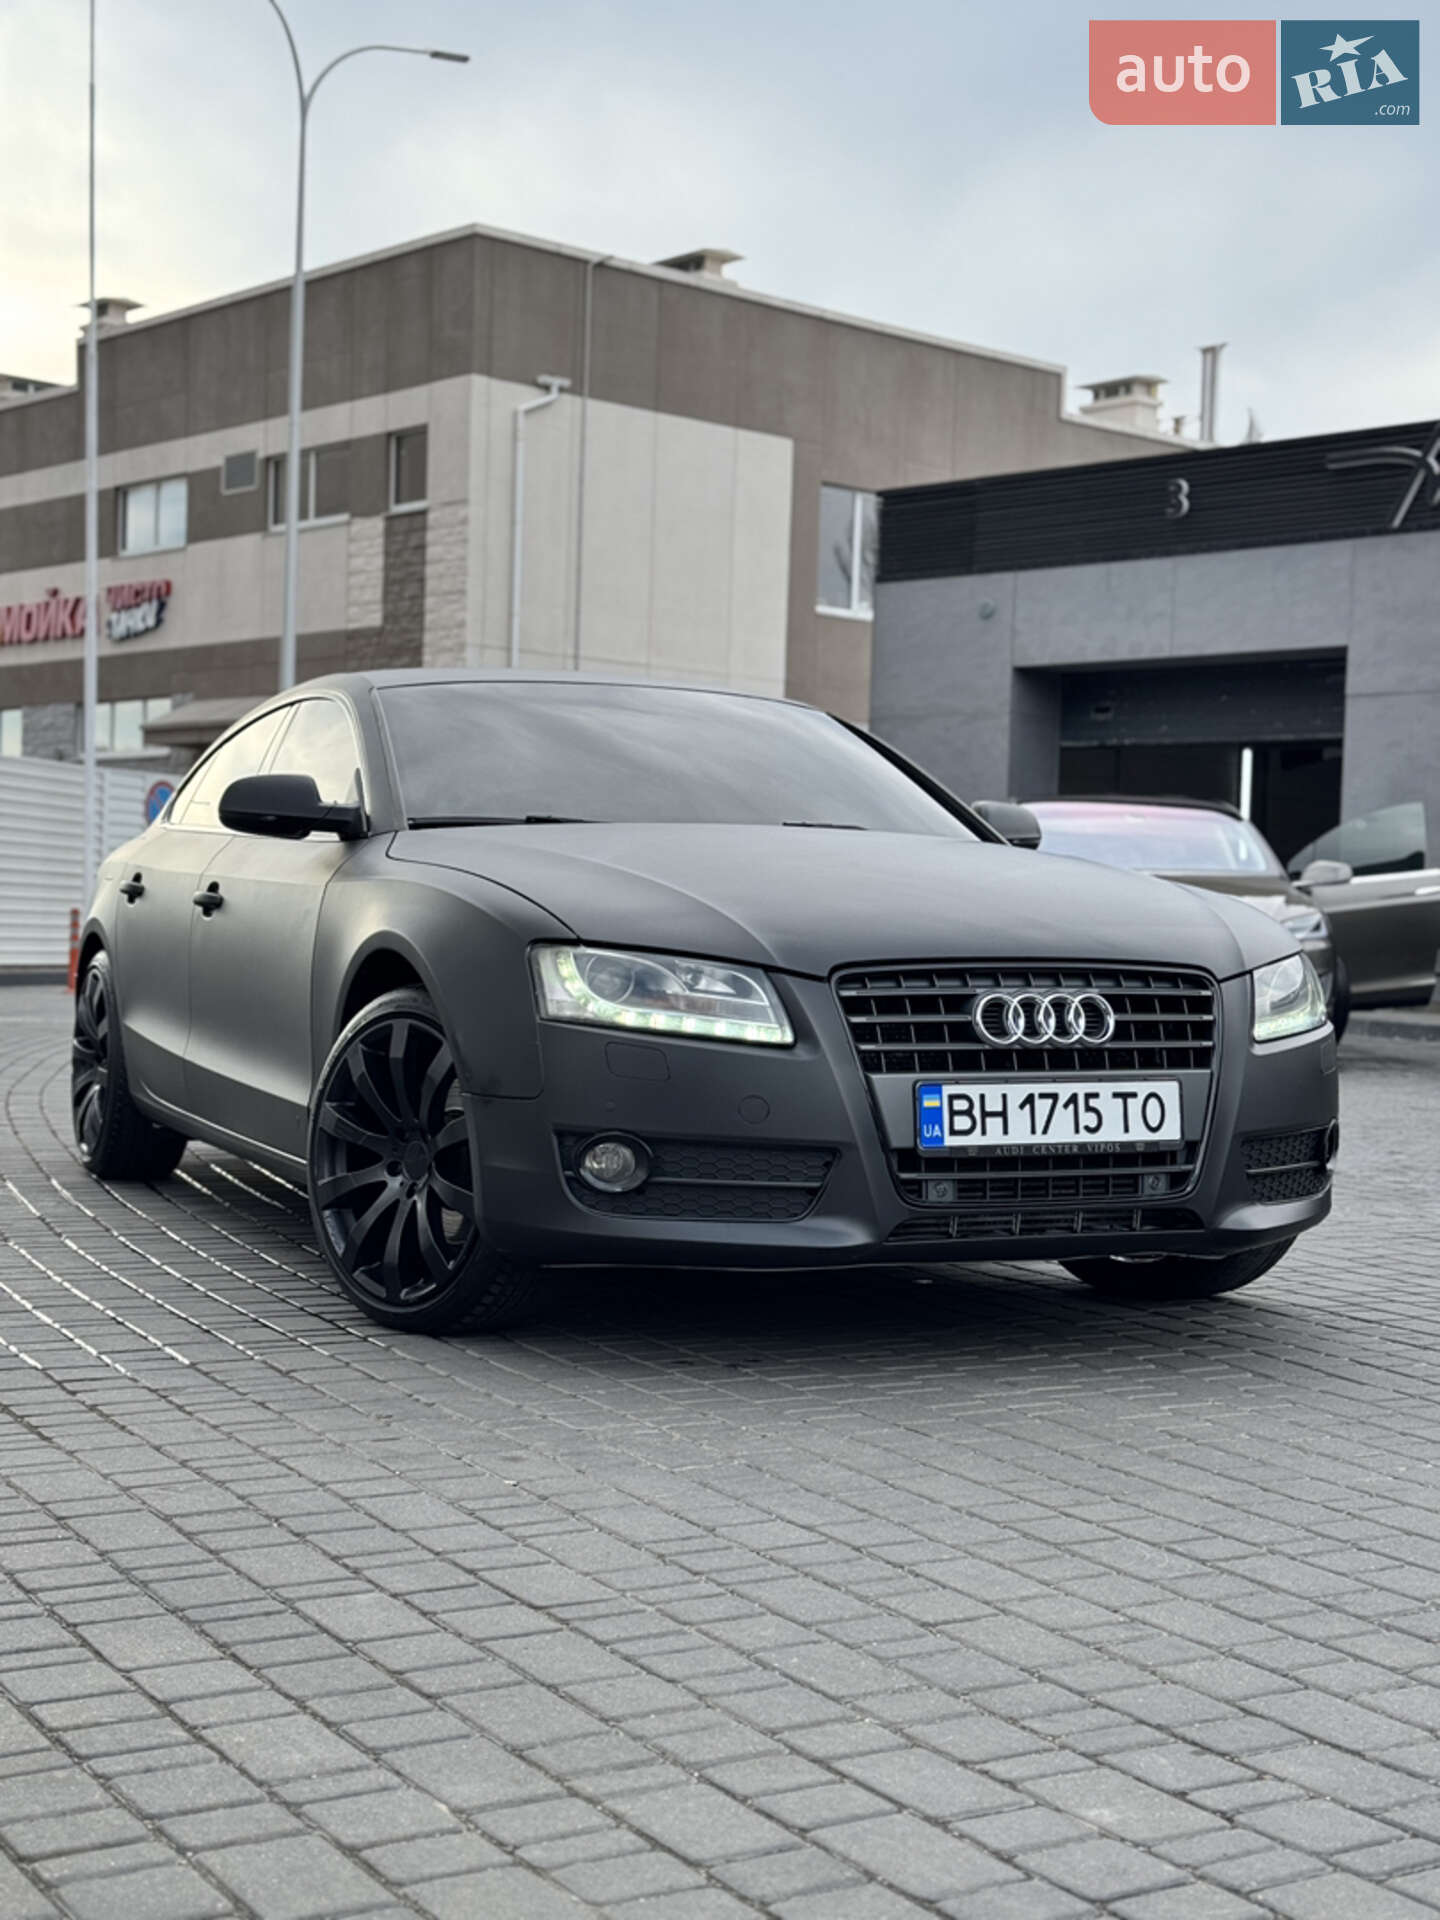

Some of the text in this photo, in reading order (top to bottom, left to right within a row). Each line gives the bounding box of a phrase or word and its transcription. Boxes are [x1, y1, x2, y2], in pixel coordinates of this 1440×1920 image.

[1166, 477, 1190, 518] 3
[947, 1091, 1166, 1137] BH 1715 TO
[923, 1124, 942, 1138] UA
[995, 1146, 1024, 1156] AUDI
[1032, 1144, 1079, 1155] CENTER
